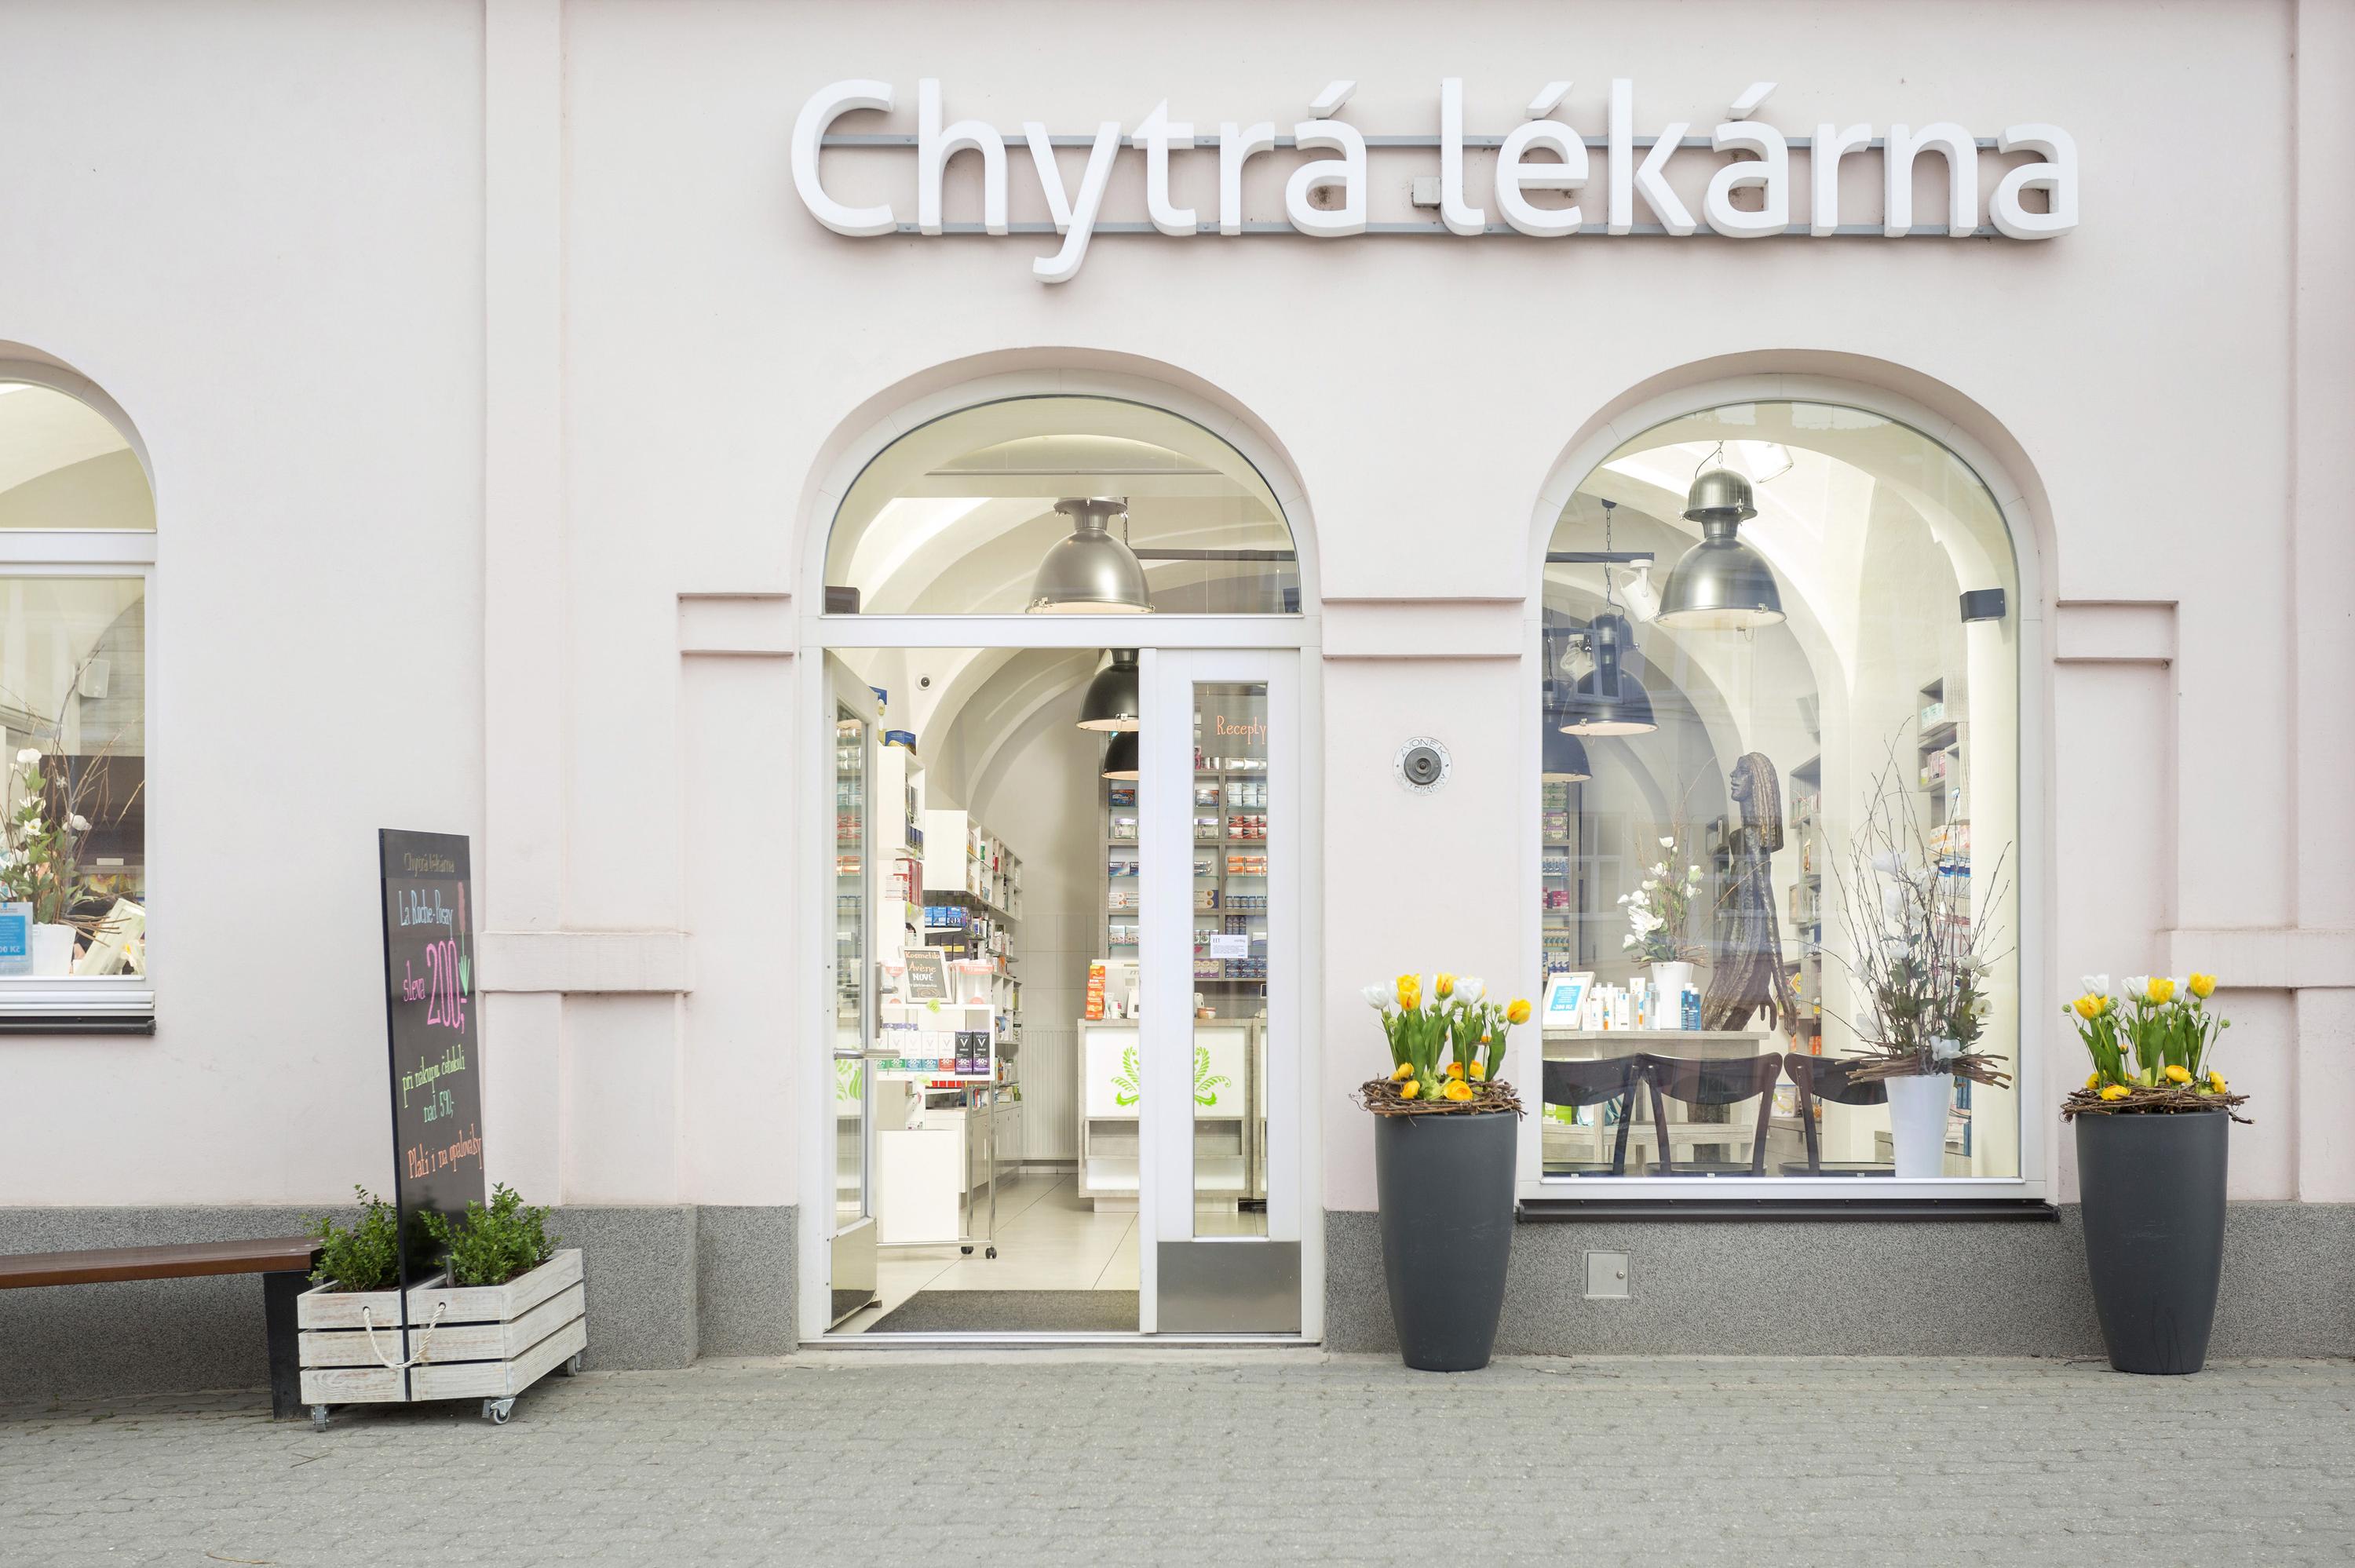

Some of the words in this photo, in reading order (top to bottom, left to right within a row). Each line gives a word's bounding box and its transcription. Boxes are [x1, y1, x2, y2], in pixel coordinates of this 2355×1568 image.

[789, 78, 1369, 284] Chytrá
[1438, 77, 2081, 240] lékárna
[1216, 715, 1266, 745] Recepty
[1401, 738, 1446, 758] ZVONEK
[399, 890, 411, 926] La
[411, 889, 454, 940] Roche-Posay
[403, 960, 426, 1002] sleva
[414, 1056, 440, 1094] nákupu
[424, 1093, 437, 1123] nad
[407, 1143, 429, 1179] Platí
[431, 1148, 436, 1172] i
[438, 1148, 448, 1169] na
